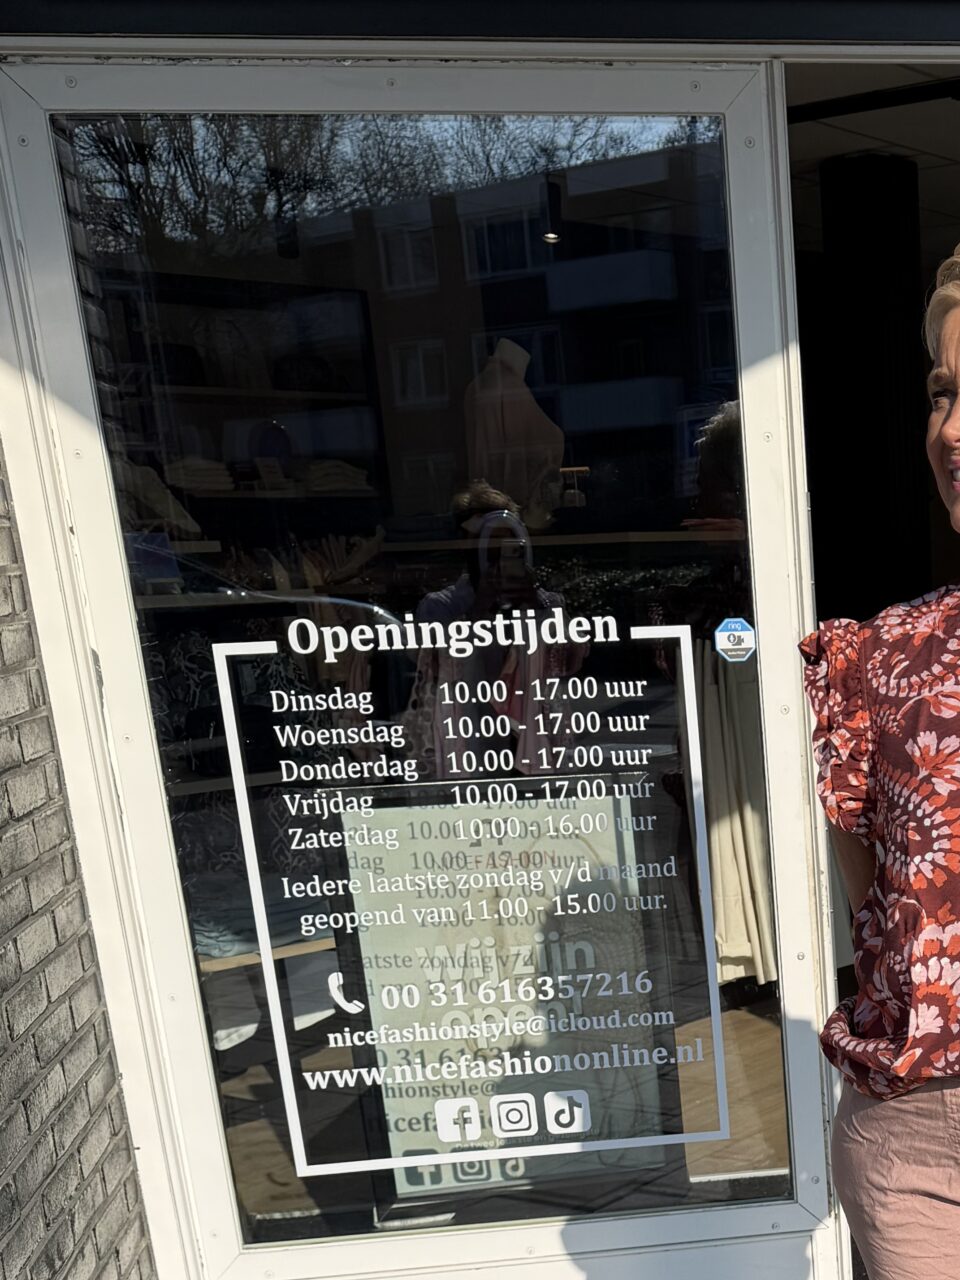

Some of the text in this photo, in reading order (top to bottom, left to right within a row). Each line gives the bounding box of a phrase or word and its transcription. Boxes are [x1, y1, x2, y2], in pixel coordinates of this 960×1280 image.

[287, 607, 620, 664] Openingstijden
[727, 622, 742, 631] ring
[269, 686, 375, 715] Dinsdag
[439, 680, 508, 705] 10.00
[531, 676, 599, 701] 17.00
[604, 679, 648, 699] uur
[273, 720, 406, 748] Woensdag
[443, 714, 511, 739] 10.00
[534, 711, 601, 735] 17.00
[607, 712, 650, 732] uur
[279, 755, 419, 781] Donderdag
[446, 749, 514, 773] 10.00
[537, 746, 604, 770] 17.00
[610, 747, 652, 767] uur
[282, 791, 375, 820] Vrijdag
[450, 783, 518, 807] 10.00
[541, 779, 606, 803] 17.00
[613, 781, 655, 800] uur
[288, 824, 400, 850] Zaterdag
[454, 816, 521, 841] 10.00
[544, 812, 609, 837] 16.00
[616, 816, 657, 832] uur
[281, 856, 678, 898] Iedere laatste zondag v/d maand
[300, 904, 407, 937] geopend
[412, 906, 456, 923] van
[462, 897, 529, 921] 11.00
[552, 892, 617, 916] 15.00
[624, 894, 668, 911] uur.
[380, 970, 653, 1010] 00 31 616357216
[327, 1009, 675, 1048] nicefashionstyle@icloud.com
[302, 1038, 705, 1091] www.nicefashiononline.nl
